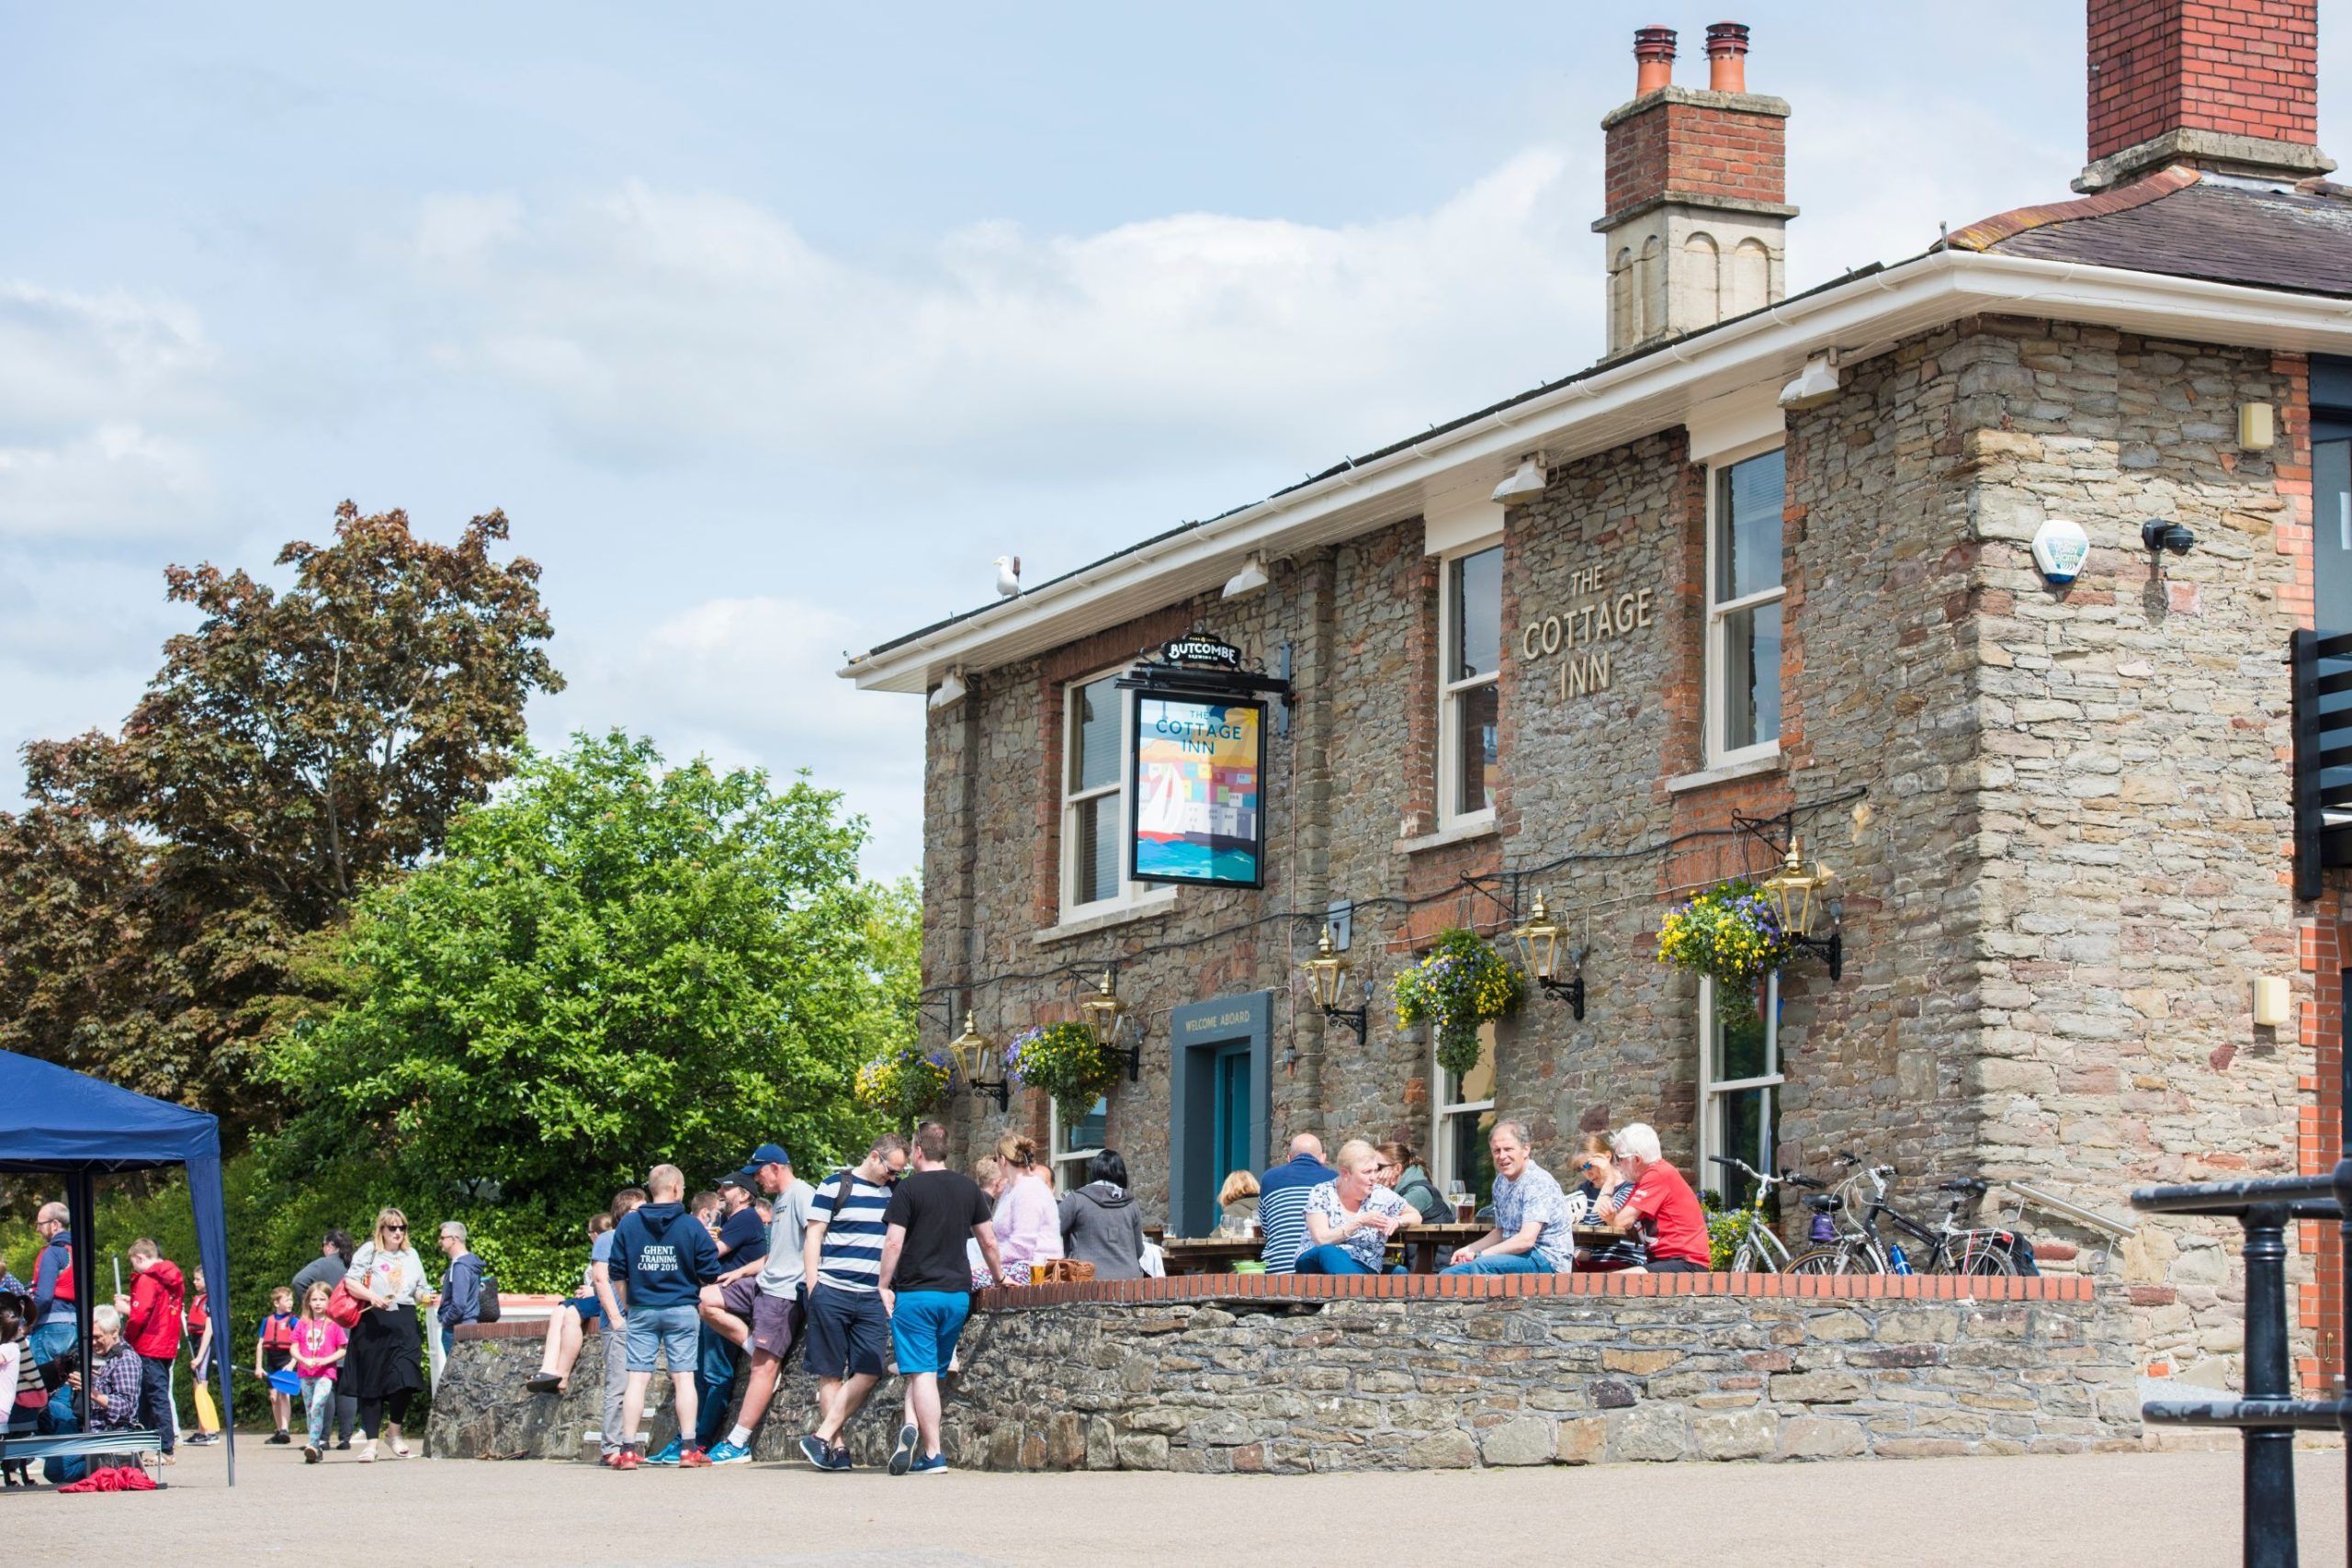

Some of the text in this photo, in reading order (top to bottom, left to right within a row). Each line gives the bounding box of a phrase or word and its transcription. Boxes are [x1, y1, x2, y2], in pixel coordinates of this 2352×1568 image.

[1571, 565, 1603, 596] THE
[1523, 587, 1654, 660] COTTAGE
[1168, 643, 1236, 664] BUTCOMBE
[1562, 650, 1610, 700] INN
[1190, 710, 1209, 720] THE
[1156, 719, 1242, 740] COTTAGE
[1182, 739, 1215, 755] INN
[1185, 1010, 1250, 1033] WELCOME ABOARD
[639, 1255, 677, 1264] TRAINING
[644, 1245, 675, 1255] GHENT
[638, 1262, 679, 1271] CAMP 2016
